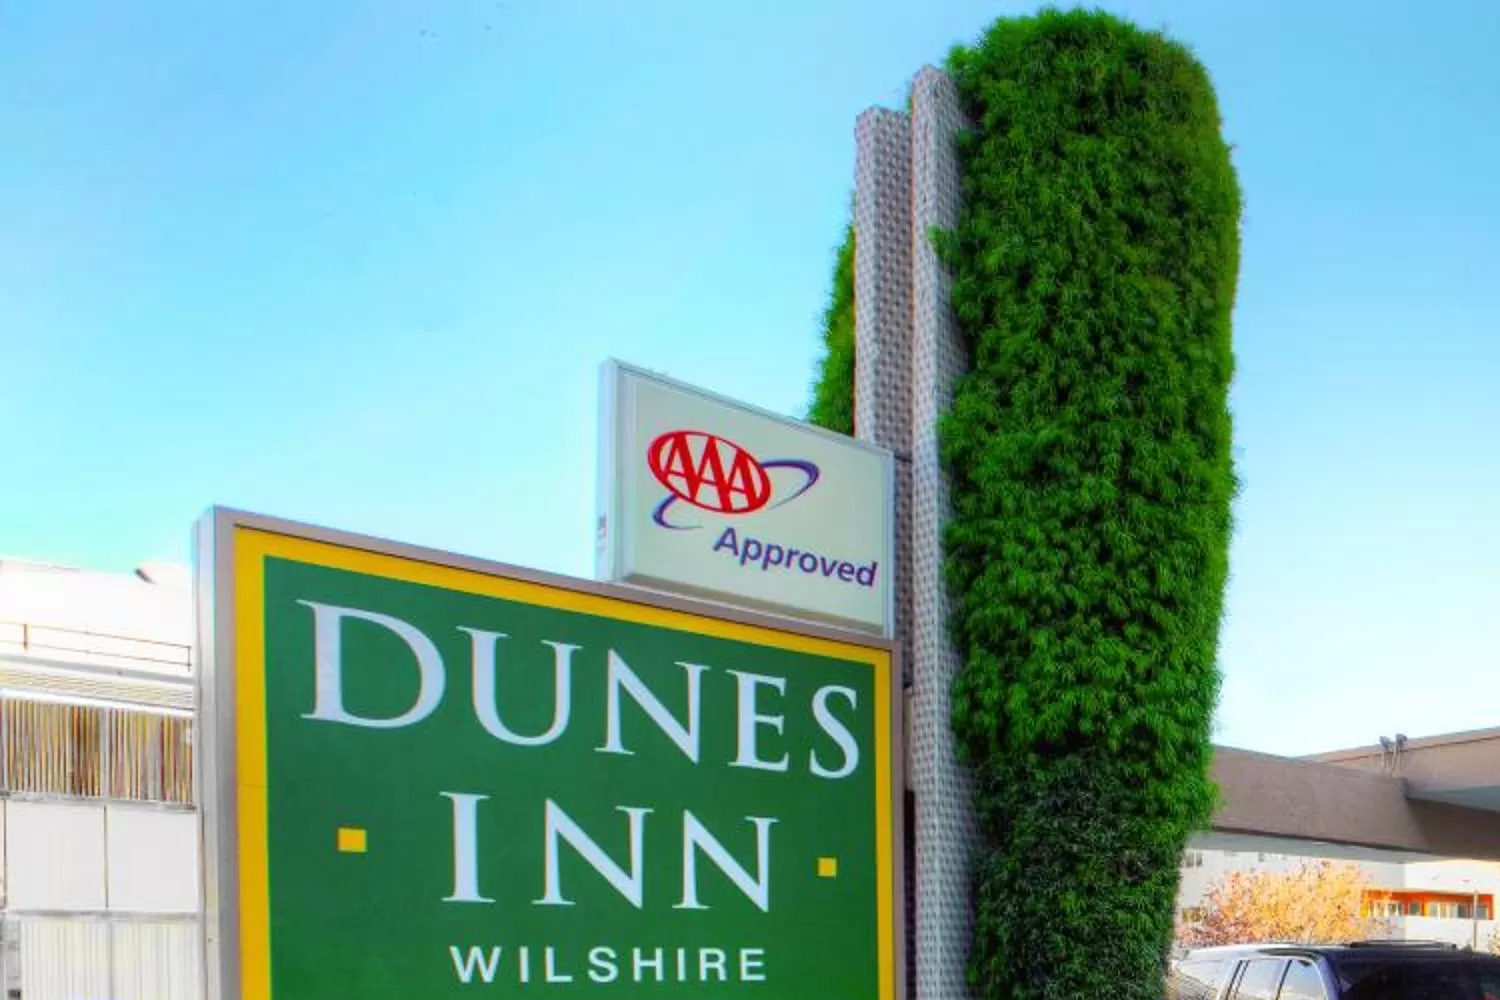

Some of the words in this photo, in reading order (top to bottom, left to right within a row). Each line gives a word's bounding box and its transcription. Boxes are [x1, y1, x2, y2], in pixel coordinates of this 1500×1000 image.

[650, 431, 771, 513] AAA
[712, 526, 878, 587] Approved
[296, 599, 861, 778] DUNES
[440, 791, 779, 912] INN
[449, 945, 766, 983] WILSHIRE
